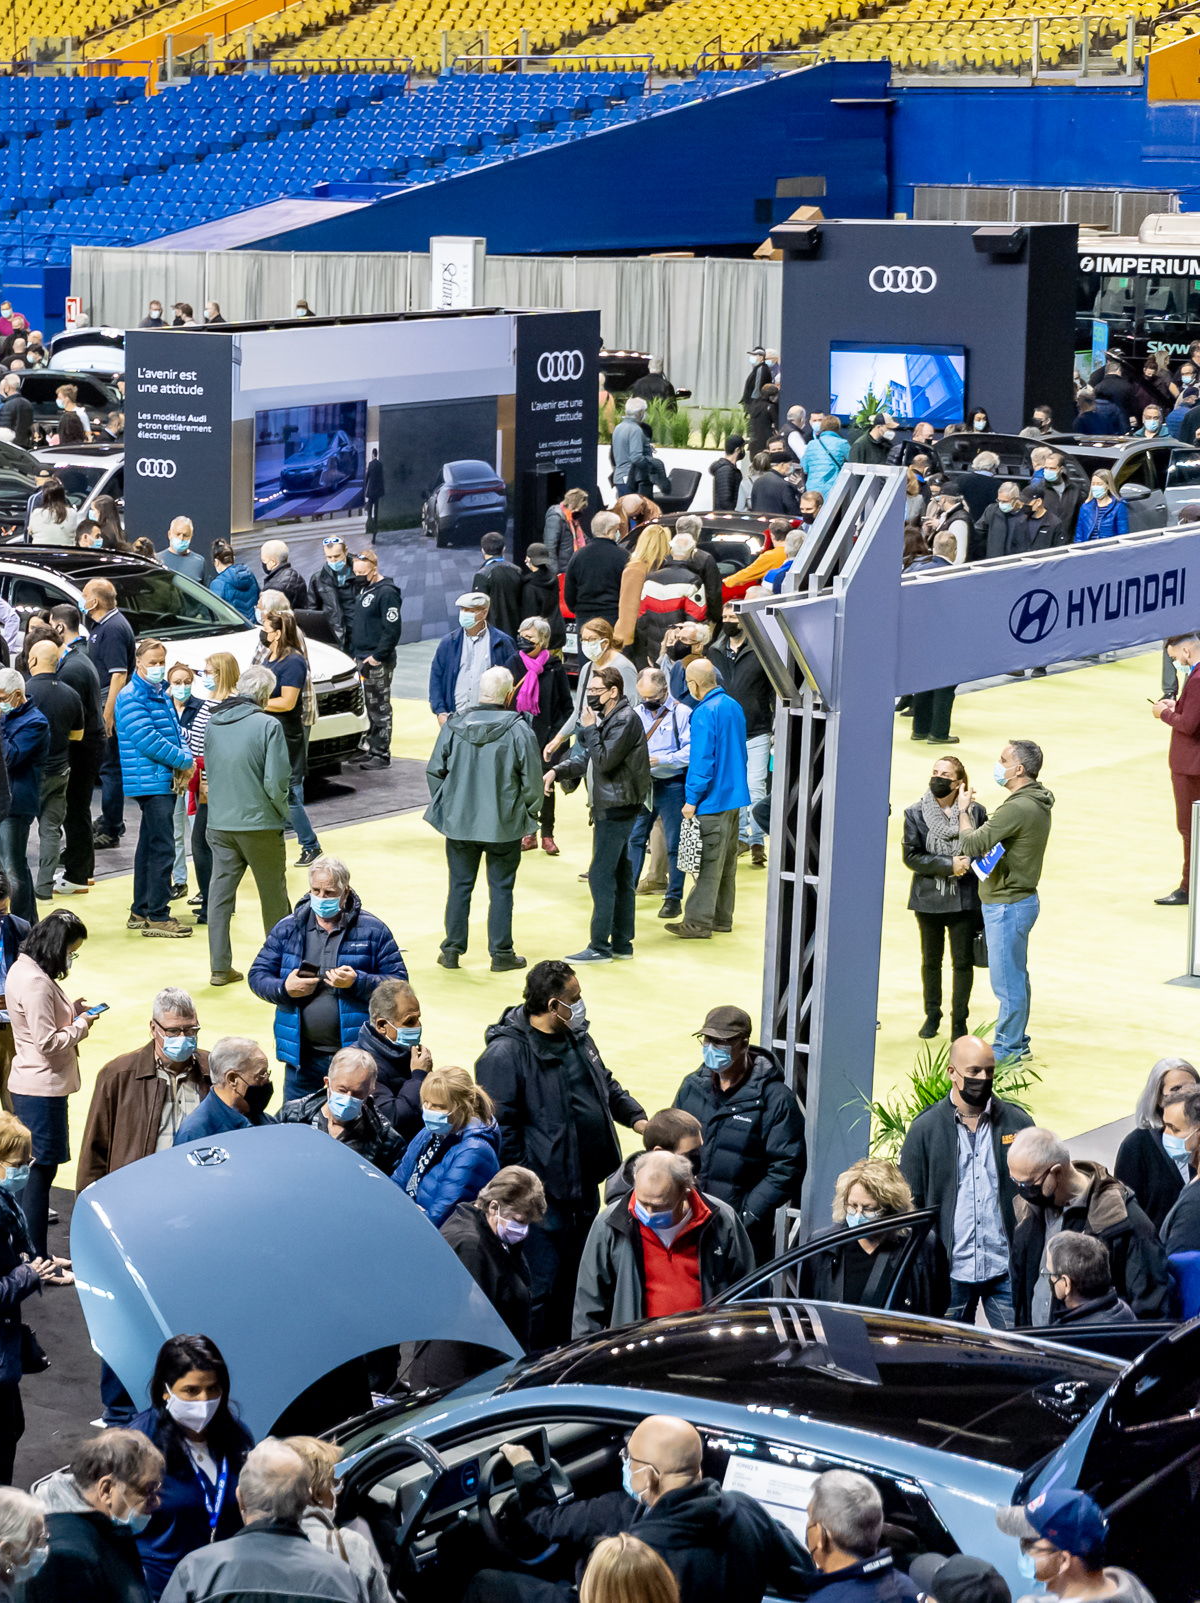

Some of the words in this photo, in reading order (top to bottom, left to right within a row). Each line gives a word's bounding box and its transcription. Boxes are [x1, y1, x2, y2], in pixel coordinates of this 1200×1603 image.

[1095, 256, 1200, 276] IMPERIUM
[137, 367, 178, 380] L'avenir
[179, 371, 197, 380] est
[138, 384, 158, 393] une
[160, 384, 204, 395] attitude
[531, 401, 557, 411] L'avenir
[558, 400, 569, 408] est
[570, 399, 583, 407] une
[137, 412, 151, 420] Les
[152, 412, 186, 422] modèles
[187, 414, 207, 423] Audi
[555, 411, 583, 422] attitude
[137, 422, 162, 430] e-tron
[163, 423, 212, 433] entièrement
[137, 431, 181, 441] électriques
[1066, 567, 1186, 629] HYUNDAI
